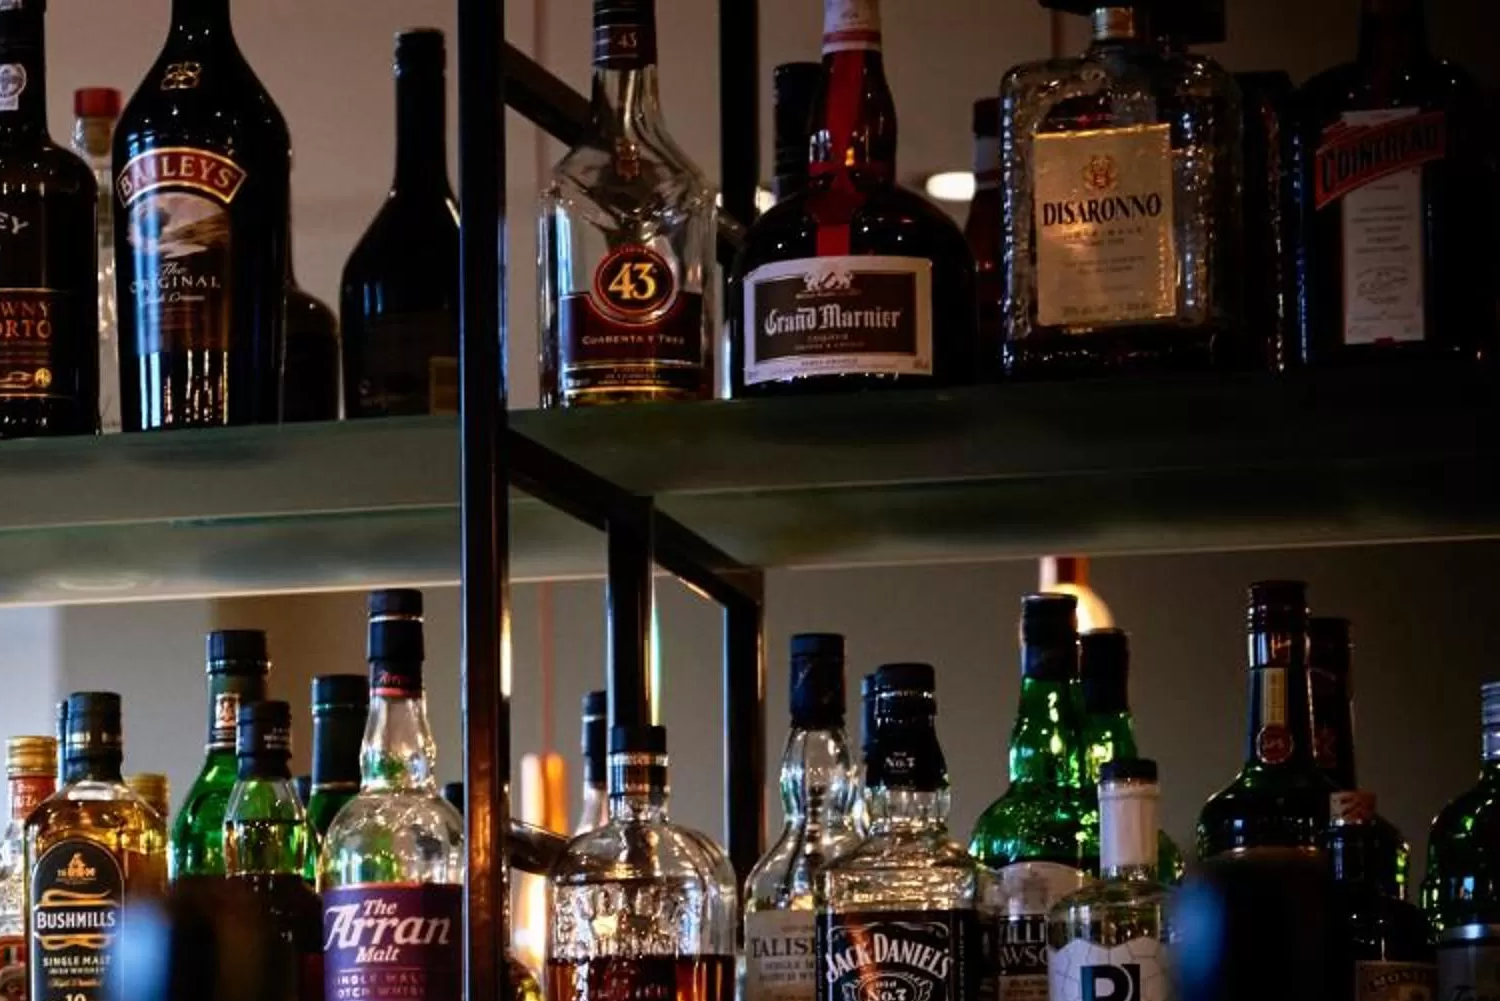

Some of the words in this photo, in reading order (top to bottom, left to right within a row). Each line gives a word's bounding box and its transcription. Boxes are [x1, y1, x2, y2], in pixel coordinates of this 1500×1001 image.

[120, 155, 234, 197] BAILEYS
[1043, 193, 1161, 226] DISARONNO
[607, 261, 658, 301] 43
[764, 307, 817, 336] Grand
[818, 303, 902, 330] Marnier
[37, 910, 116, 930] BUSHMILLS
[364, 899, 398, 916] The
[324, 904, 450, 951] Arran
[43, 957, 79, 967] SINGLE
[83, 956, 111, 966] MALT
[356, 946, 400, 963] Malt
[825, 944, 873, 982] JACK
[874, 933, 955, 979] DANIEL'S
